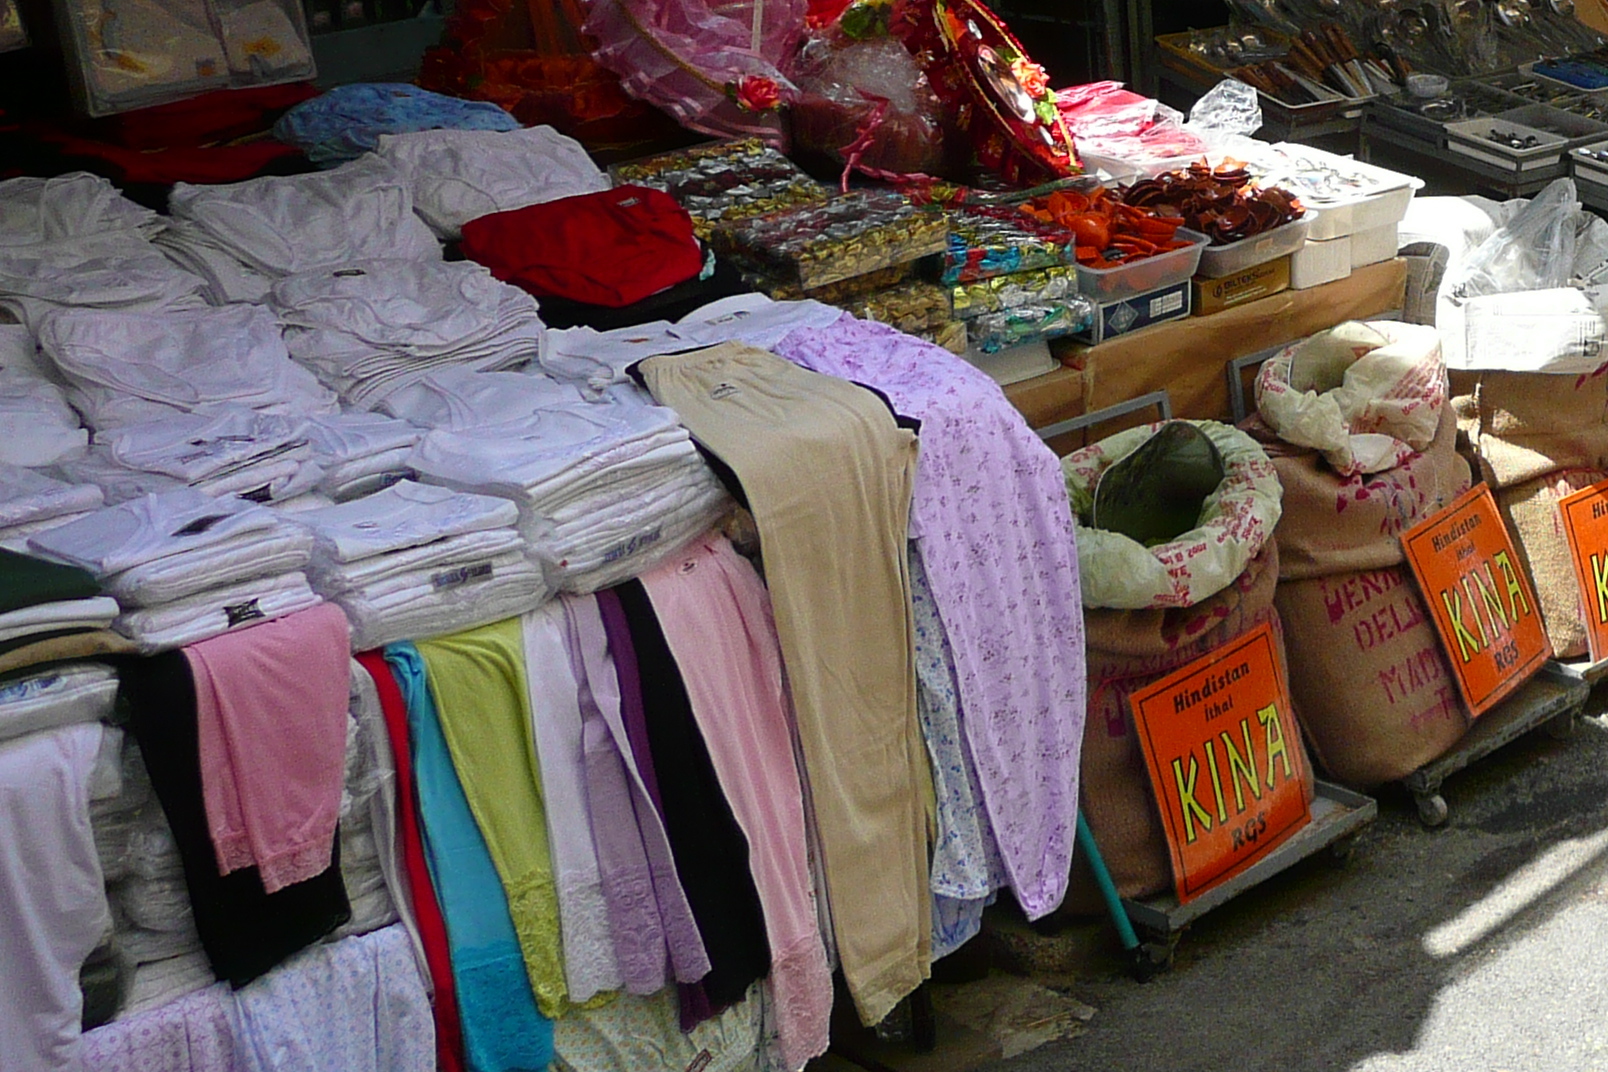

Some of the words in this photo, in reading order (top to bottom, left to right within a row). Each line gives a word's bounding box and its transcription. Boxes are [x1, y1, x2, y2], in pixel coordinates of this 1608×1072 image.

[1431, 513, 1483, 554] Hindistan
[1440, 549, 1531, 664] KINA
[1493, 640, 1520, 673] RGS
[1173, 661, 1251, 716] Hindistan
[1170, 701, 1293, 846] KINA
[1230, 811, 1268, 853] RGS
